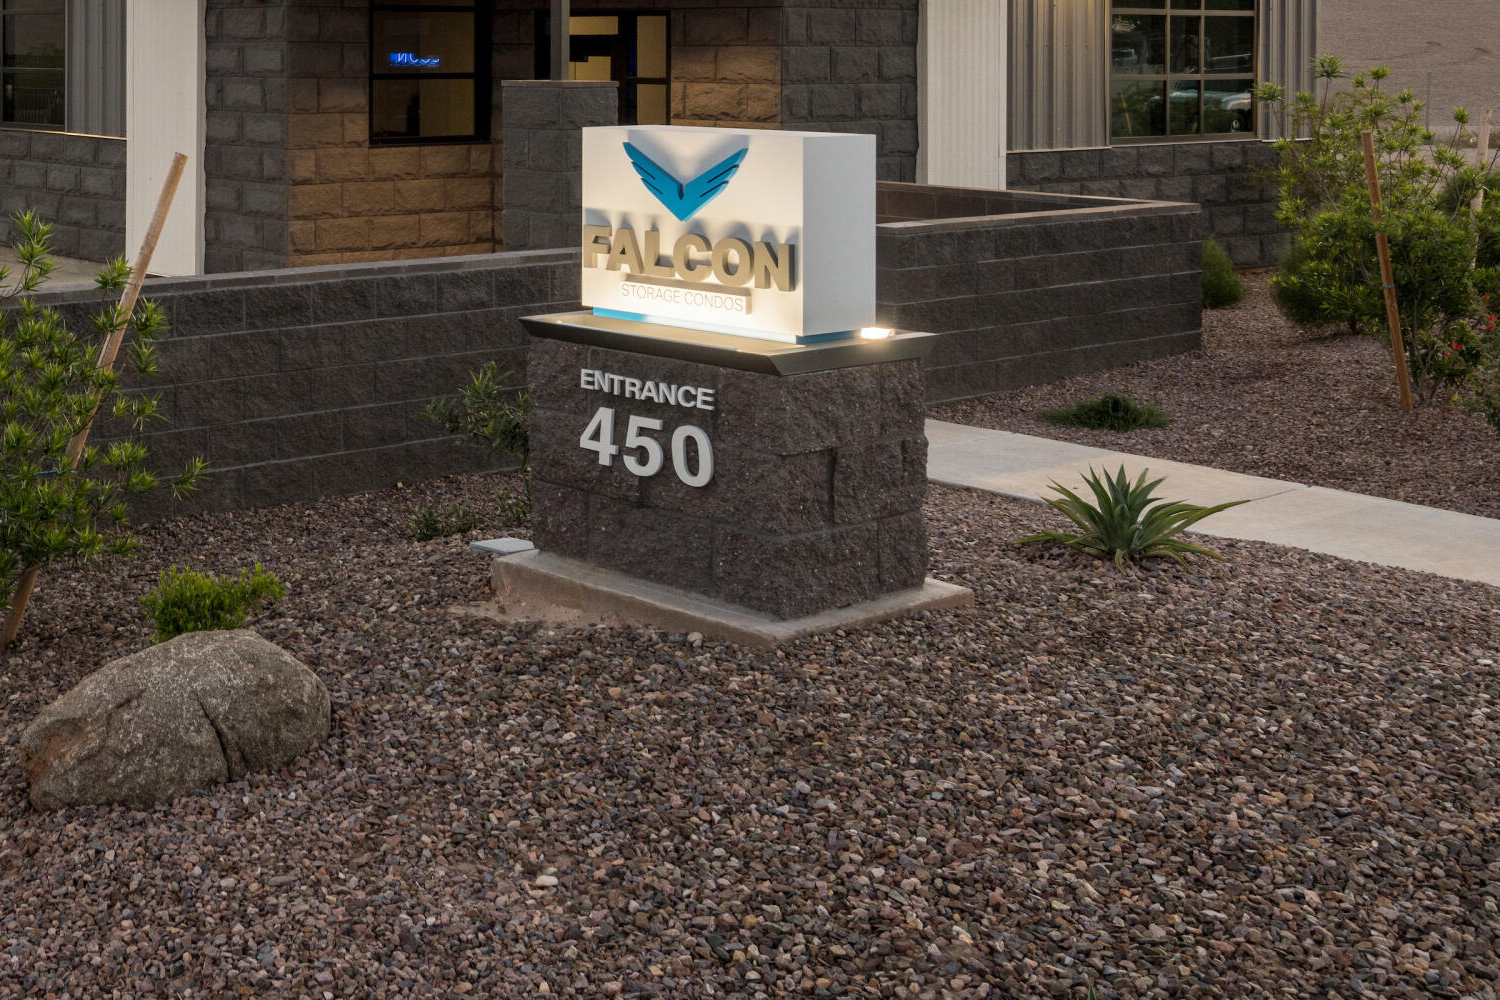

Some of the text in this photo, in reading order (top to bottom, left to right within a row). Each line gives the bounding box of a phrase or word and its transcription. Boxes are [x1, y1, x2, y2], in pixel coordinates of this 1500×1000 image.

[583, 224, 796, 291] FALCON
[620, 283, 744, 312] STORAGE CONDOS
[580, 368, 715, 411] ENTRANCE
[579, 406, 715, 488] 450
